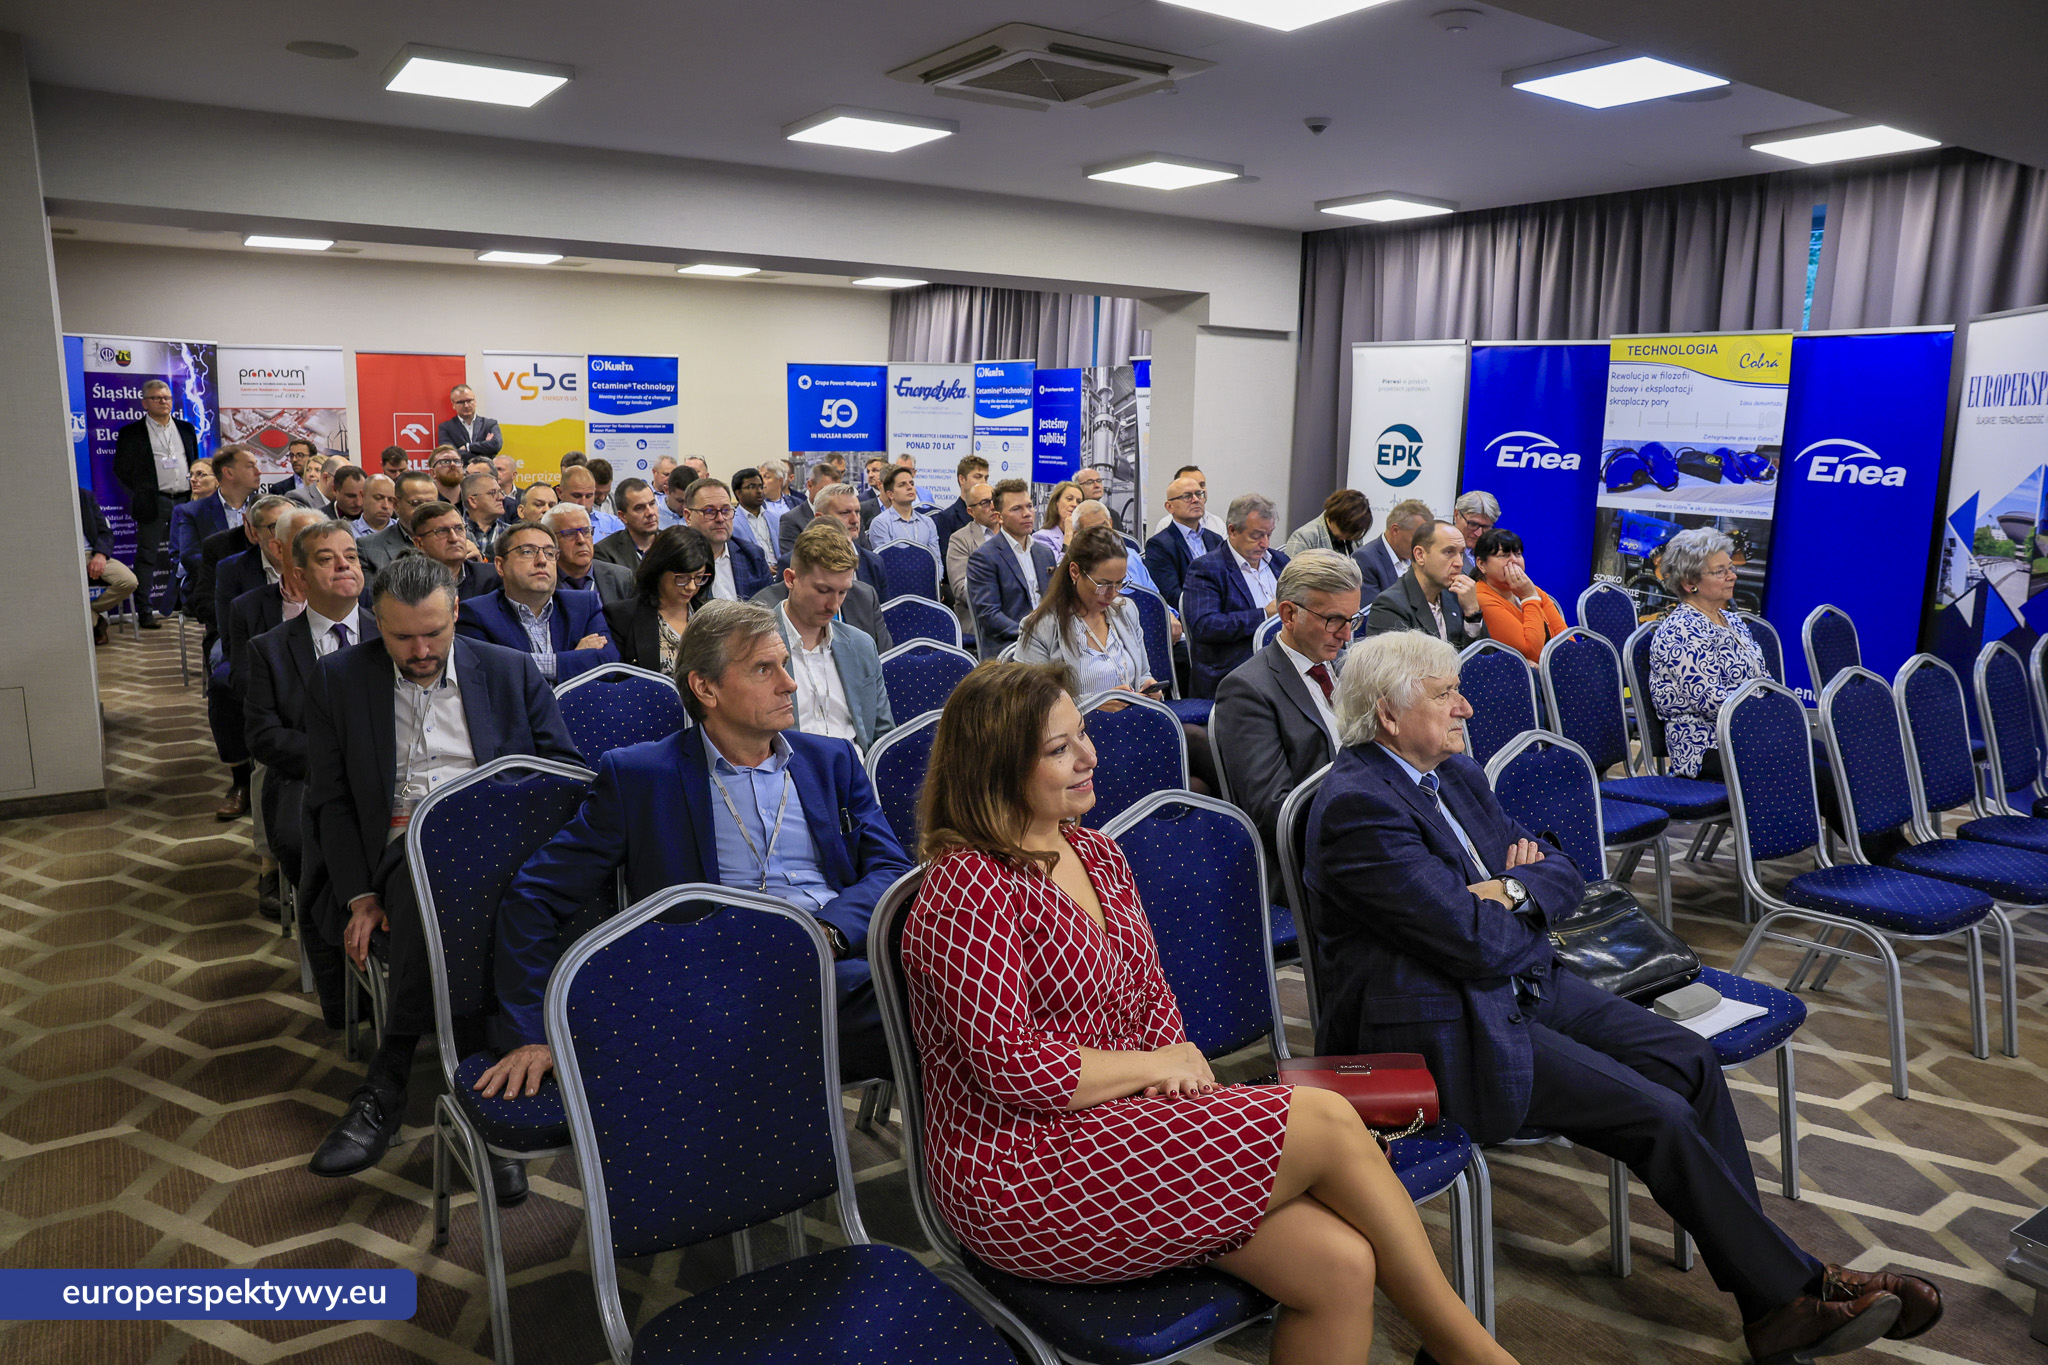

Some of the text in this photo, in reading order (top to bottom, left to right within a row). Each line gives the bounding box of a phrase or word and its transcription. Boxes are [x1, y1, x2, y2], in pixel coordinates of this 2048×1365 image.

[1627, 344, 1718, 356] TECHNOLOGIA
[1739, 353, 1779, 369] Cobra
[1611, 371, 1650, 382] Rewolucja
[1660, 370, 1690, 380] filozofii
[92, 383, 144, 402] Śląskie
[632, 382, 675, 392] Technology
[893, 376, 967, 403] Energetyka
[1002, 386, 1032, 396] Technology
[1610, 384, 1639, 395] budowy
[1645, 384, 1694, 396] eksploatacji
[1609, 397, 1669, 408] skraplaczy pary
[94, 407, 184, 422] Wiadoci
[819, 398, 859, 428] 50
[1038, 417, 1069, 432] Jesteśmy
[906, 441, 955, 450] PONAD 70 LAT
[1039, 432, 1067, 447] najbliżej
[1377, 444, 1424, 467] EPK
[1496, 445, 1581, 470] Enea
[407, 459, 430, 471] RLE
[1807, 455, 1907, 487] Enea
[515, 471, 561, 483] nergize
[1593, 573, 1622, 584] SZYBKO
